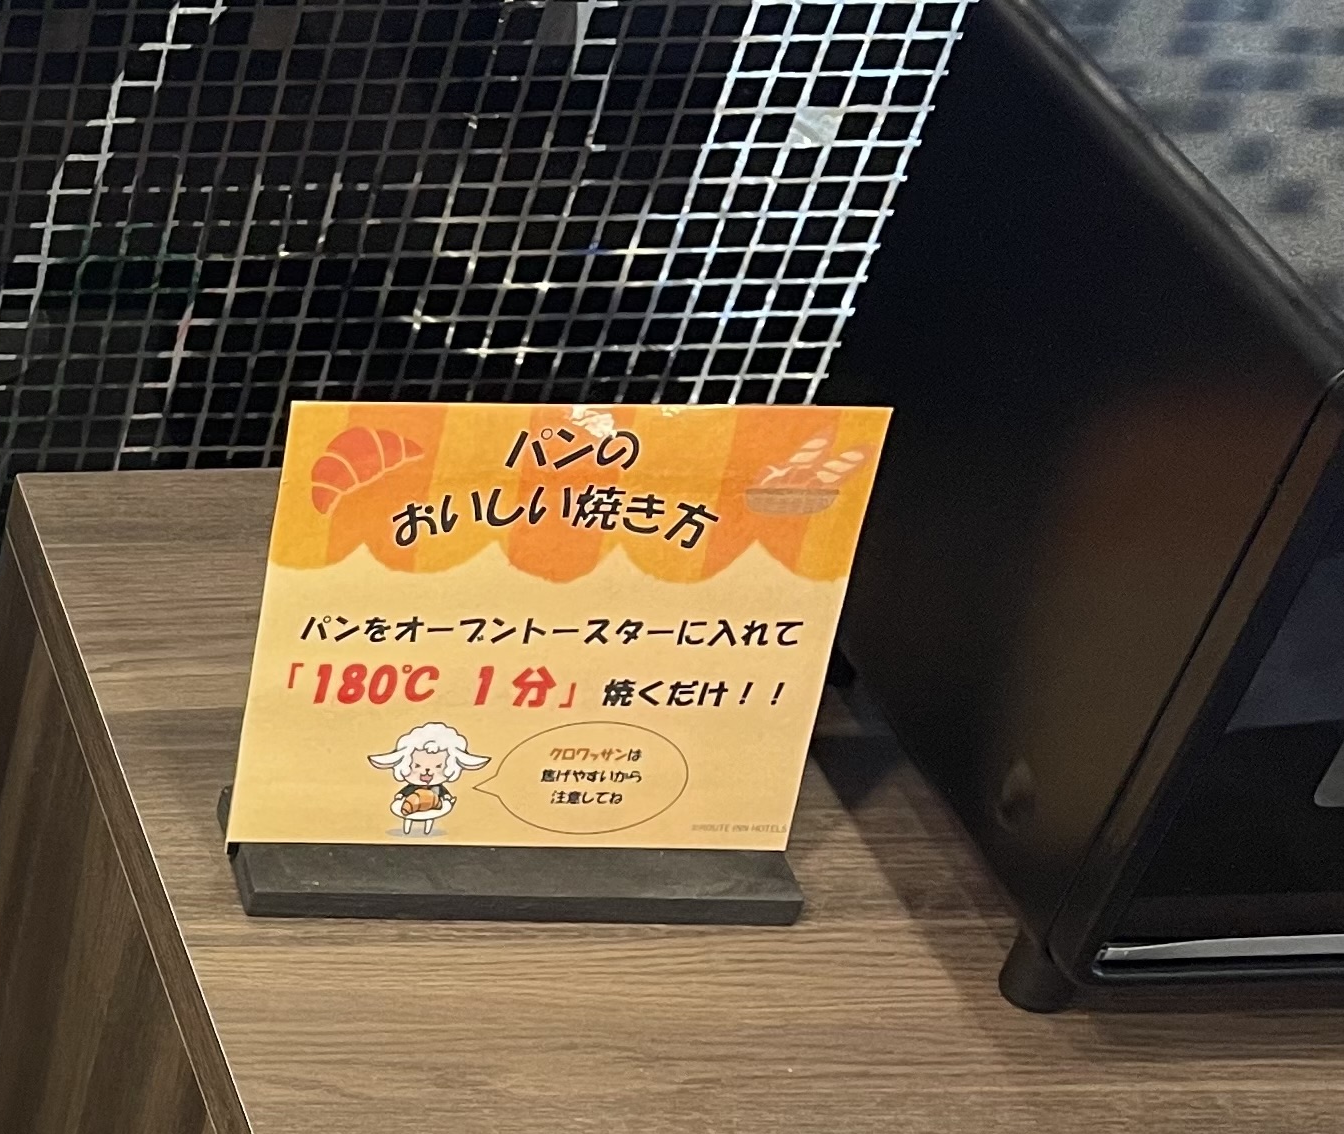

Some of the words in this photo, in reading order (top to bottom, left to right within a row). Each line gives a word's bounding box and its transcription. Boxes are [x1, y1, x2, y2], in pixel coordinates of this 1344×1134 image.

[505, 428, 640, 470] パンの
[392, 485, 719, 549] おいしい焼き方
[300, 616, 804, 646] パンをオーブントースターに入れて
[550, 749, 642, 762] クロワッサンは
[541, 769, 642, 783] 焦げやすいから
[550, 791, 623, 804] 注意してね
